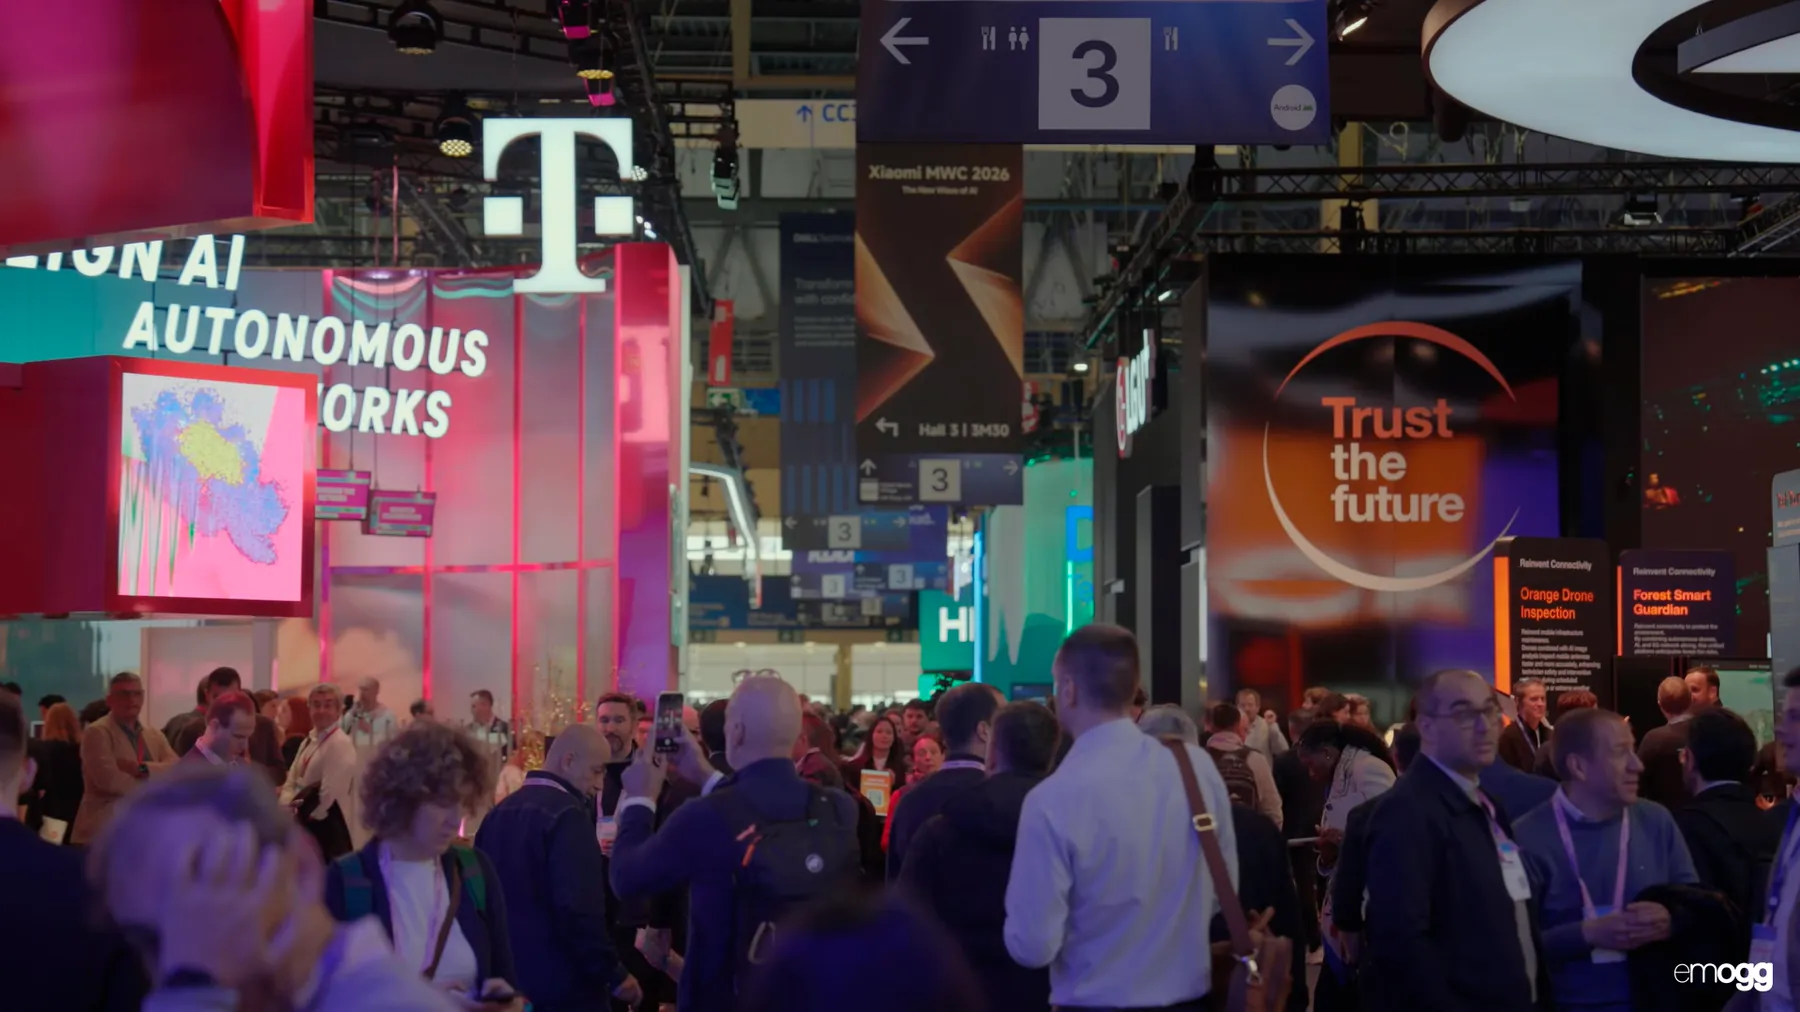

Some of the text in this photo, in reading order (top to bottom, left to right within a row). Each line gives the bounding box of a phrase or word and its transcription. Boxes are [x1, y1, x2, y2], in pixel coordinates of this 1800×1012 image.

[1069, 40, 1120, 108] 3
[1274, 103, 1302, 112] Android
[868, 164, 1011, 182] Xiaomi MWC 2026
[178, 234, 245, 290] AI
[122, 302, 489, 377] AUTONOMOUS
[317, 383, 452, 438] ORKS
[1321, 397, 1453, 438] Trust
[919, 423, 945, 436] Hall
[949, 424, 959, 436] 3
[971, 424, 1010, 436] 3M30
[1330, 442, 1407, 481] the
[931, 467, 949, 492] 3
[1330, 484, 1465, 523] future
[838, 522, 852, 542] 3
[1520, 558, 1592, 572] Reinvent Connectivity
[1633, 567, 1716, 577] Reinvent Connectivity
[1520, 587, 1594, 604] Orange Drone
[1633, 589, 1712, 601] Forest Smart
[1520, 605, 1576, 621] Inspection
[1633, 603, 1688, 616] Guardian
